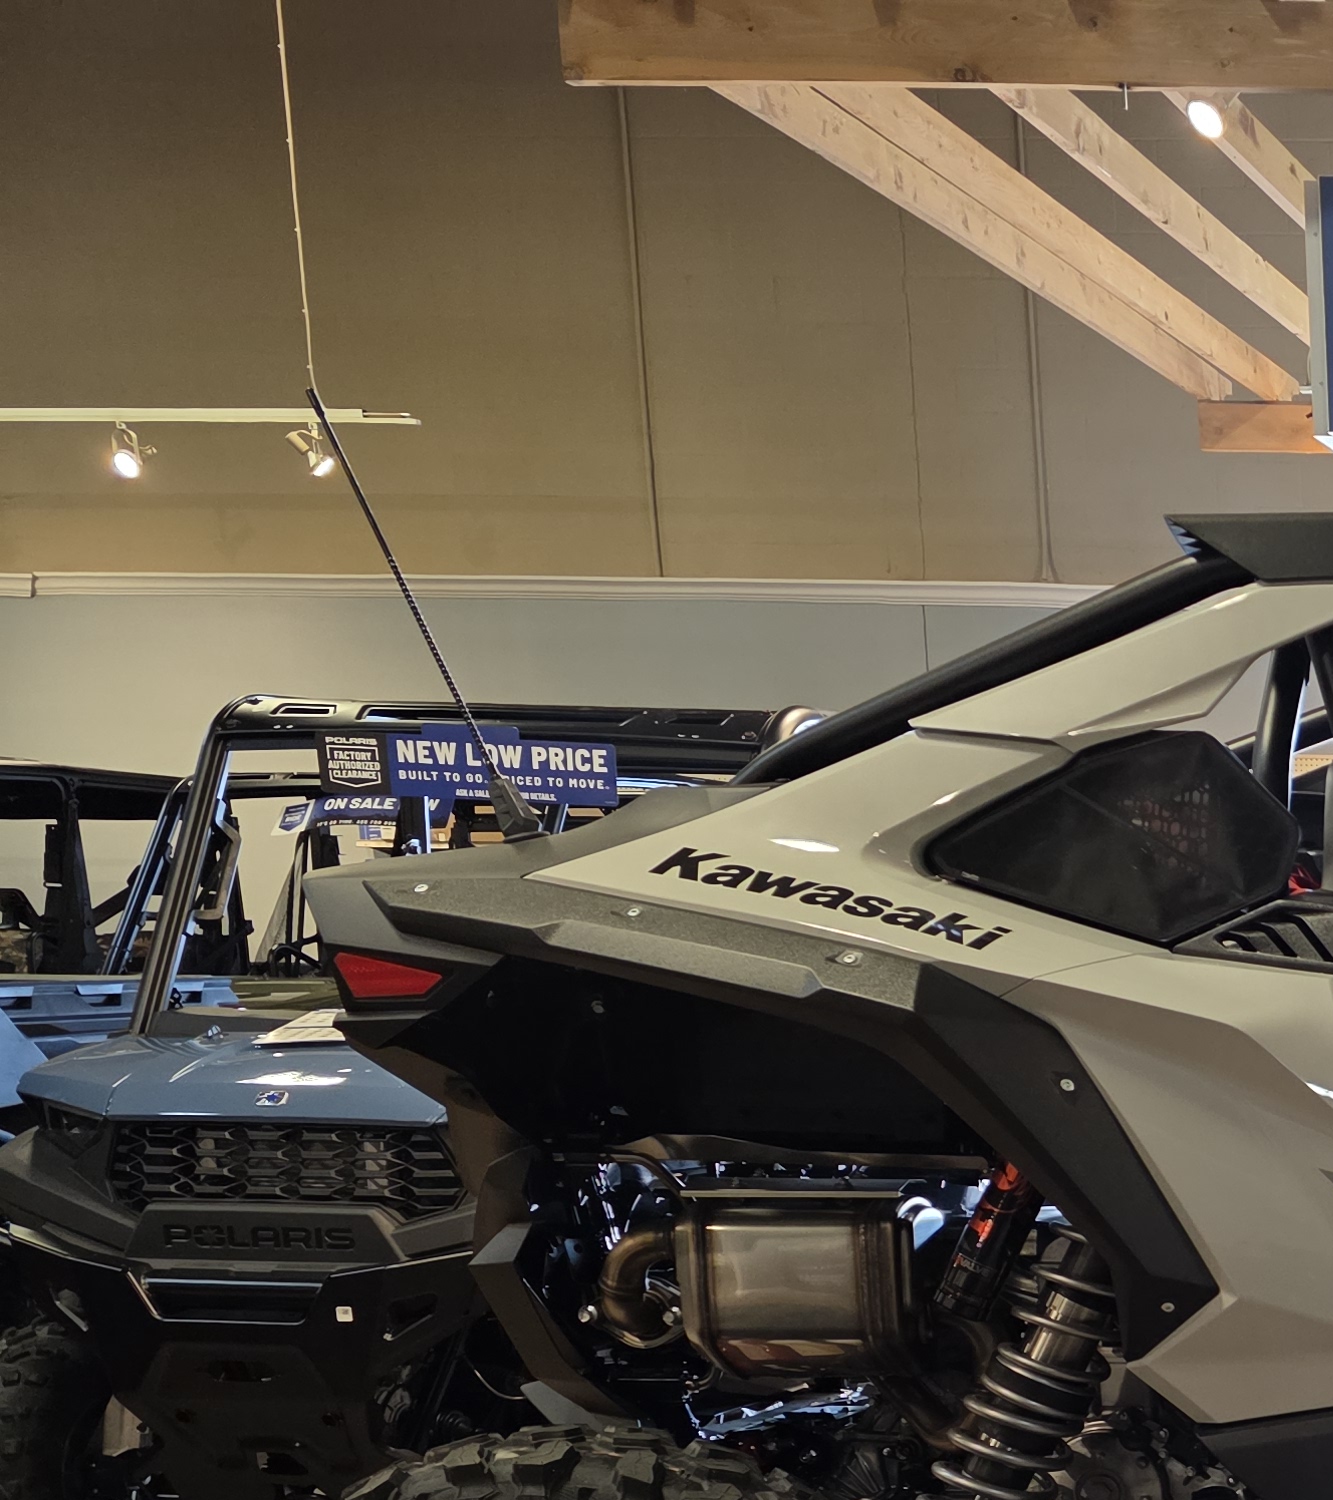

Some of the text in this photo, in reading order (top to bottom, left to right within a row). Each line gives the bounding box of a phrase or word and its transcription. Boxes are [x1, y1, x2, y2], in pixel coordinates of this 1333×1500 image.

[325, 736, 378, 746] POLARIS
[333, 750, 372, 760] FACTORY
[396, 739, 609, 773] NEW LOW PRICE
[328, 760, 381, 771] AUTHORIZED
[332, 770, 378, 780] CLEARANCE
[398, 769, 439, 781] BUILT
[443, 771, 461, 782] TO
[546, 777, 564, 788] TO
[323, 797, 397, 811] ON SALE
[648, 846, 1013, 951] Kawasaki
[162, 1224, 356, 1250] POLARIS
